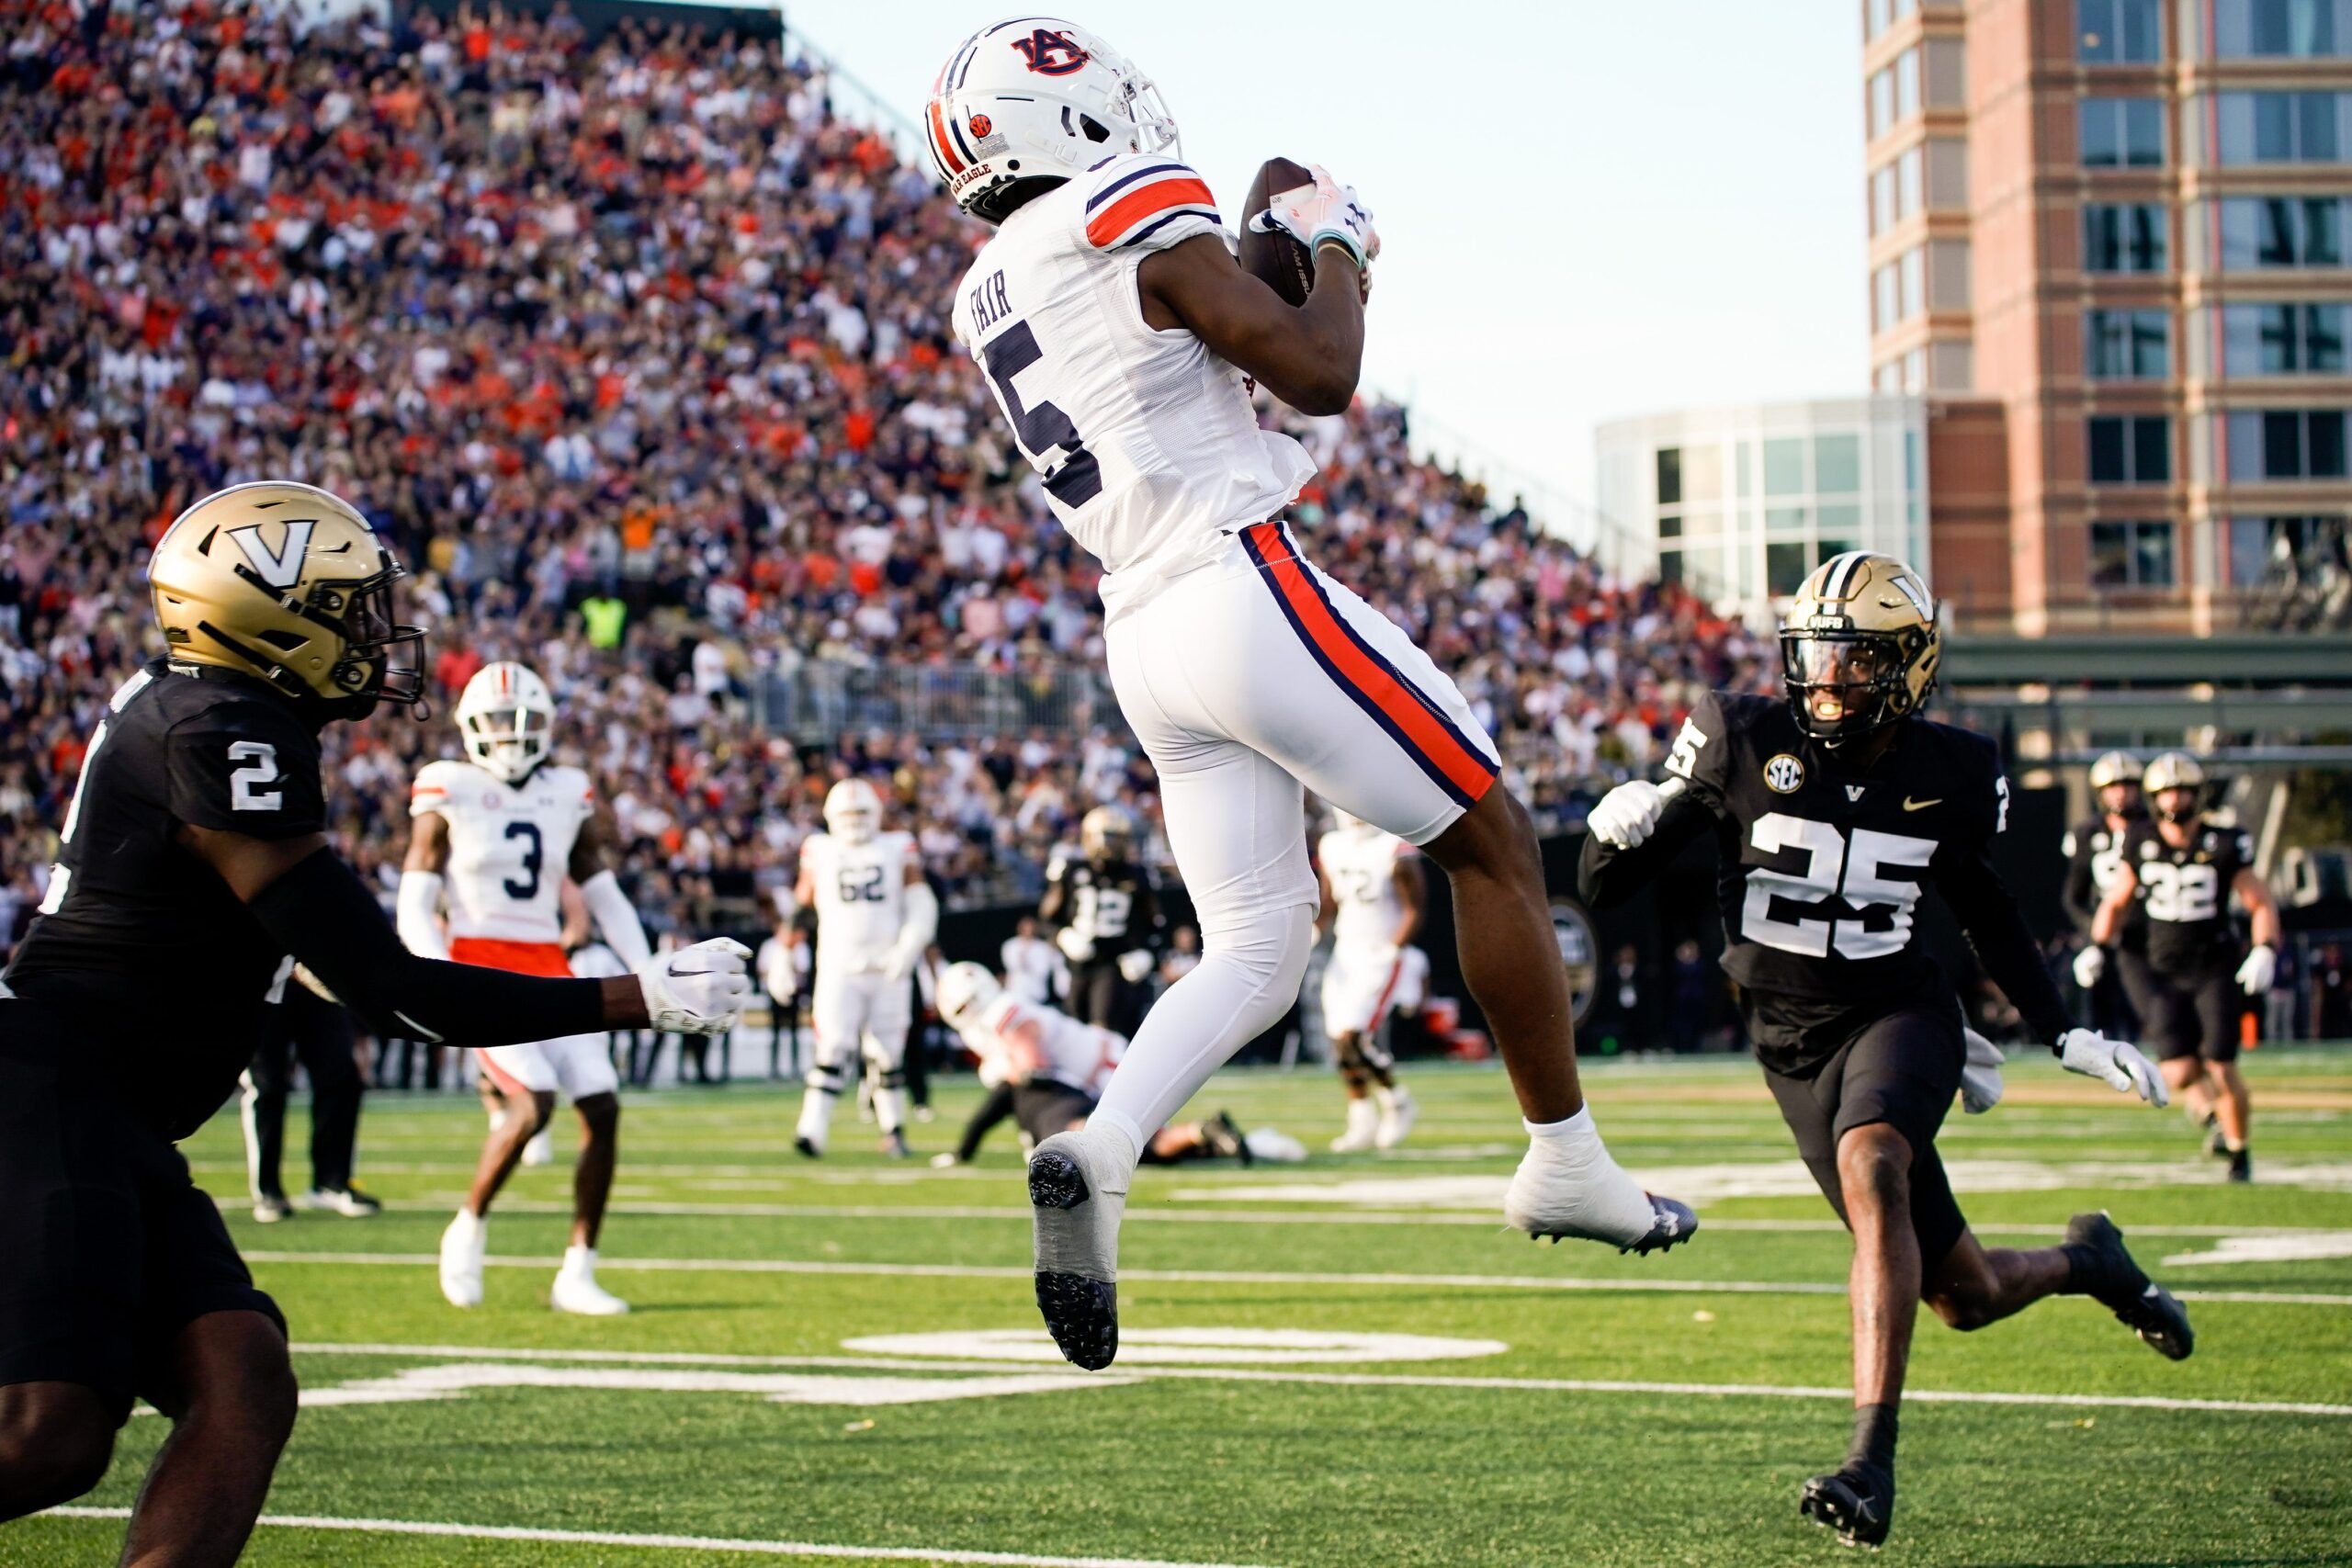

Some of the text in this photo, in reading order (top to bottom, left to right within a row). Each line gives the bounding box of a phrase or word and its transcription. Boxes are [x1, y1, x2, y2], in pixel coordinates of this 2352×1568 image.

[970, 115, 992, 138] SEC
[961, 164, 992, 185] EAGLE
[970, 268, 1012, 336] FAIR
[984, 319, 1102, 510] 5
[223, 519, 320, 591] V
[1809, 615, 1845, 629] VUFB
[228, 740, 282, 811] 2
[1769, 756, 1802, 792] SEC
[1845, 784, 1865, 802] V
[503, 820, 542, 899] 3
[839, 865, 885, 903] 62
[1741, 811, 1939, 961] 25
[1072, 884, 1132, 938] 12
[2140, 861, 2219, 922] 32
